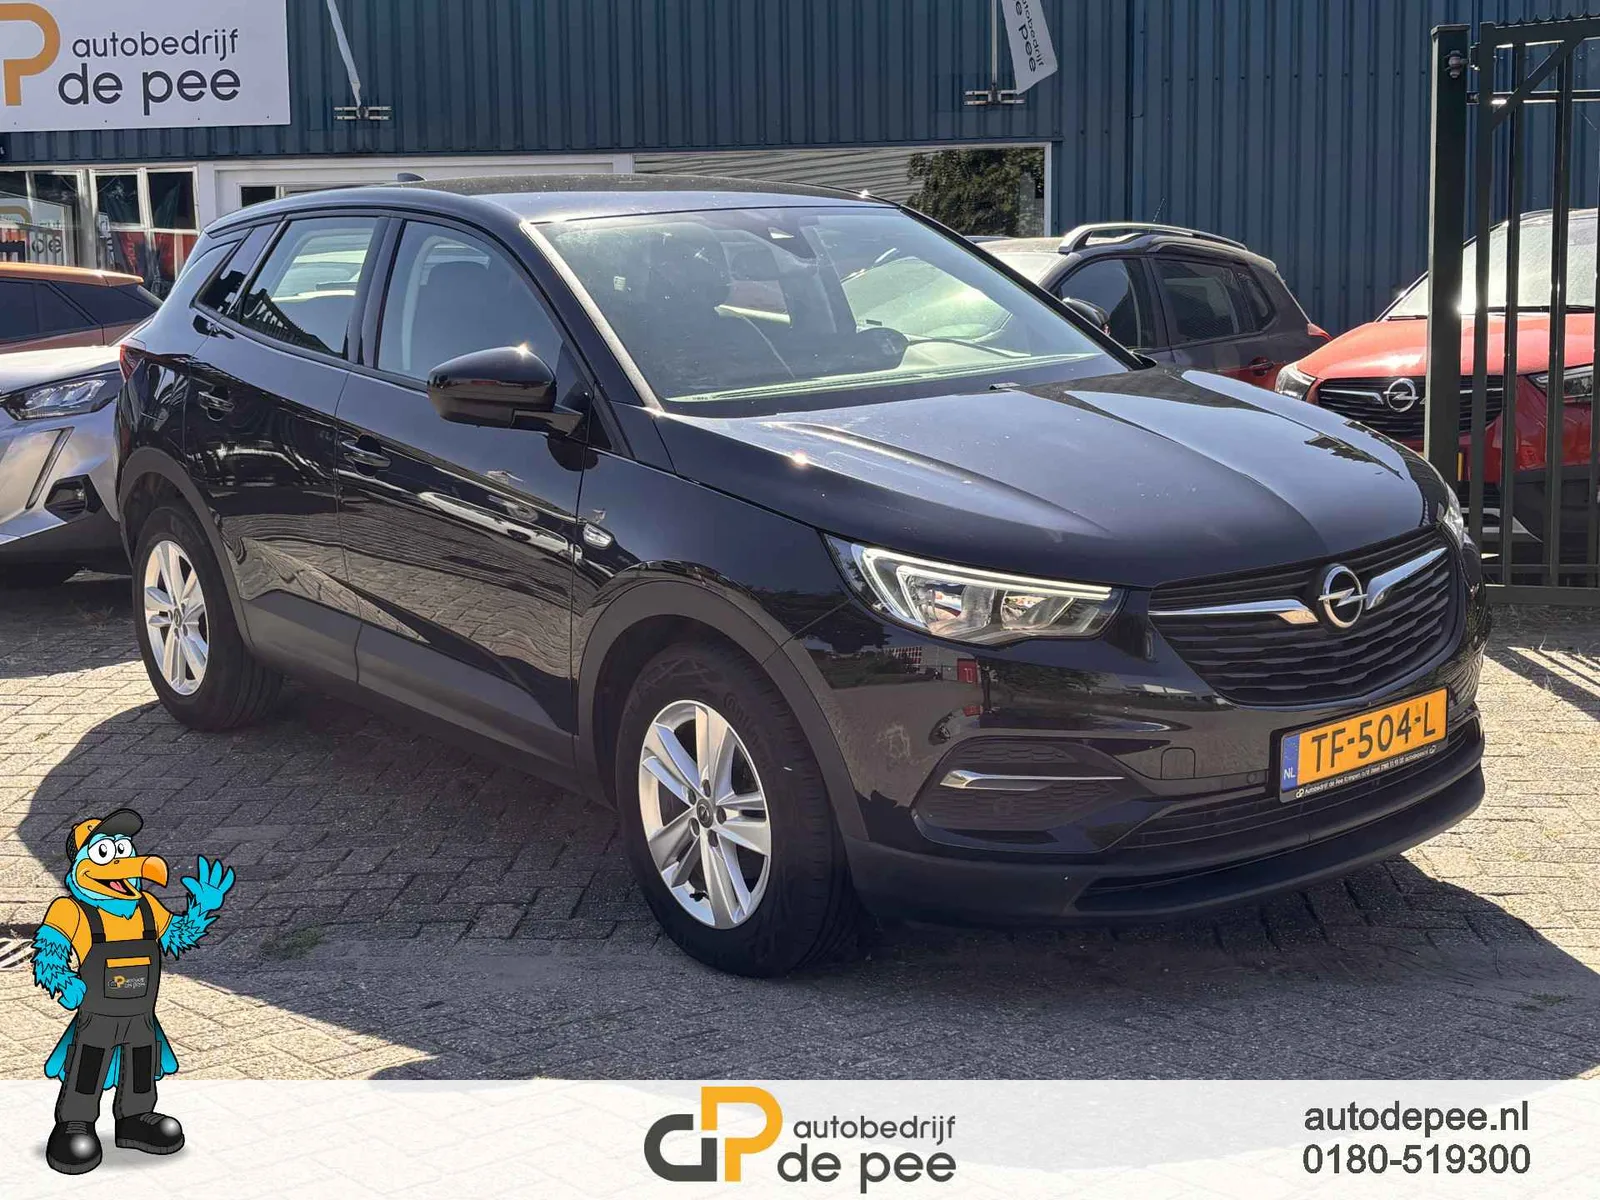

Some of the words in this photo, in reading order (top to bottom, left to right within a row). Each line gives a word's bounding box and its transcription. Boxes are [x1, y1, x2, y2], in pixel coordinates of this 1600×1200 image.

[72, 28, 239, 61] autobedrijf
[1018, 24, 1036, 72] pee
[58, 63, 123, 105] de
[142, 68, 241, 116] pee
[1311, 702, 1436, 773] TF-504-L
[1283, 767, 1296, 780] NL
